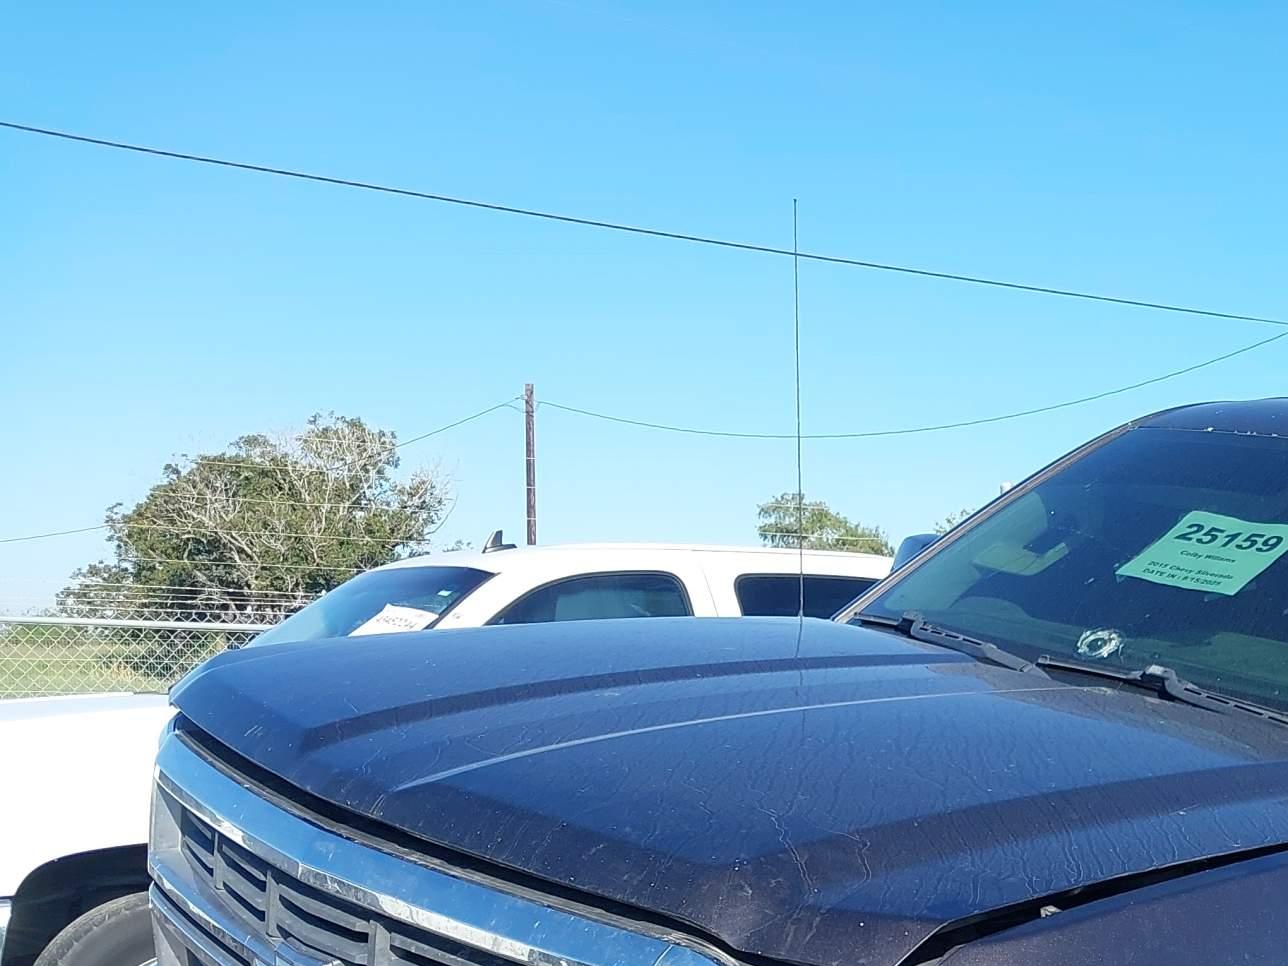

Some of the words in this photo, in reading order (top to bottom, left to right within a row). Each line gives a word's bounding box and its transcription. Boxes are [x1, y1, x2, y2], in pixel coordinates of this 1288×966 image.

[1174, 523, 1284, 553] 25159
[1142, 568, 1167, 577] DATE
[1169, 565, 1194, 574] Chevy
[1195, 570, 1234, 580] Silverado
